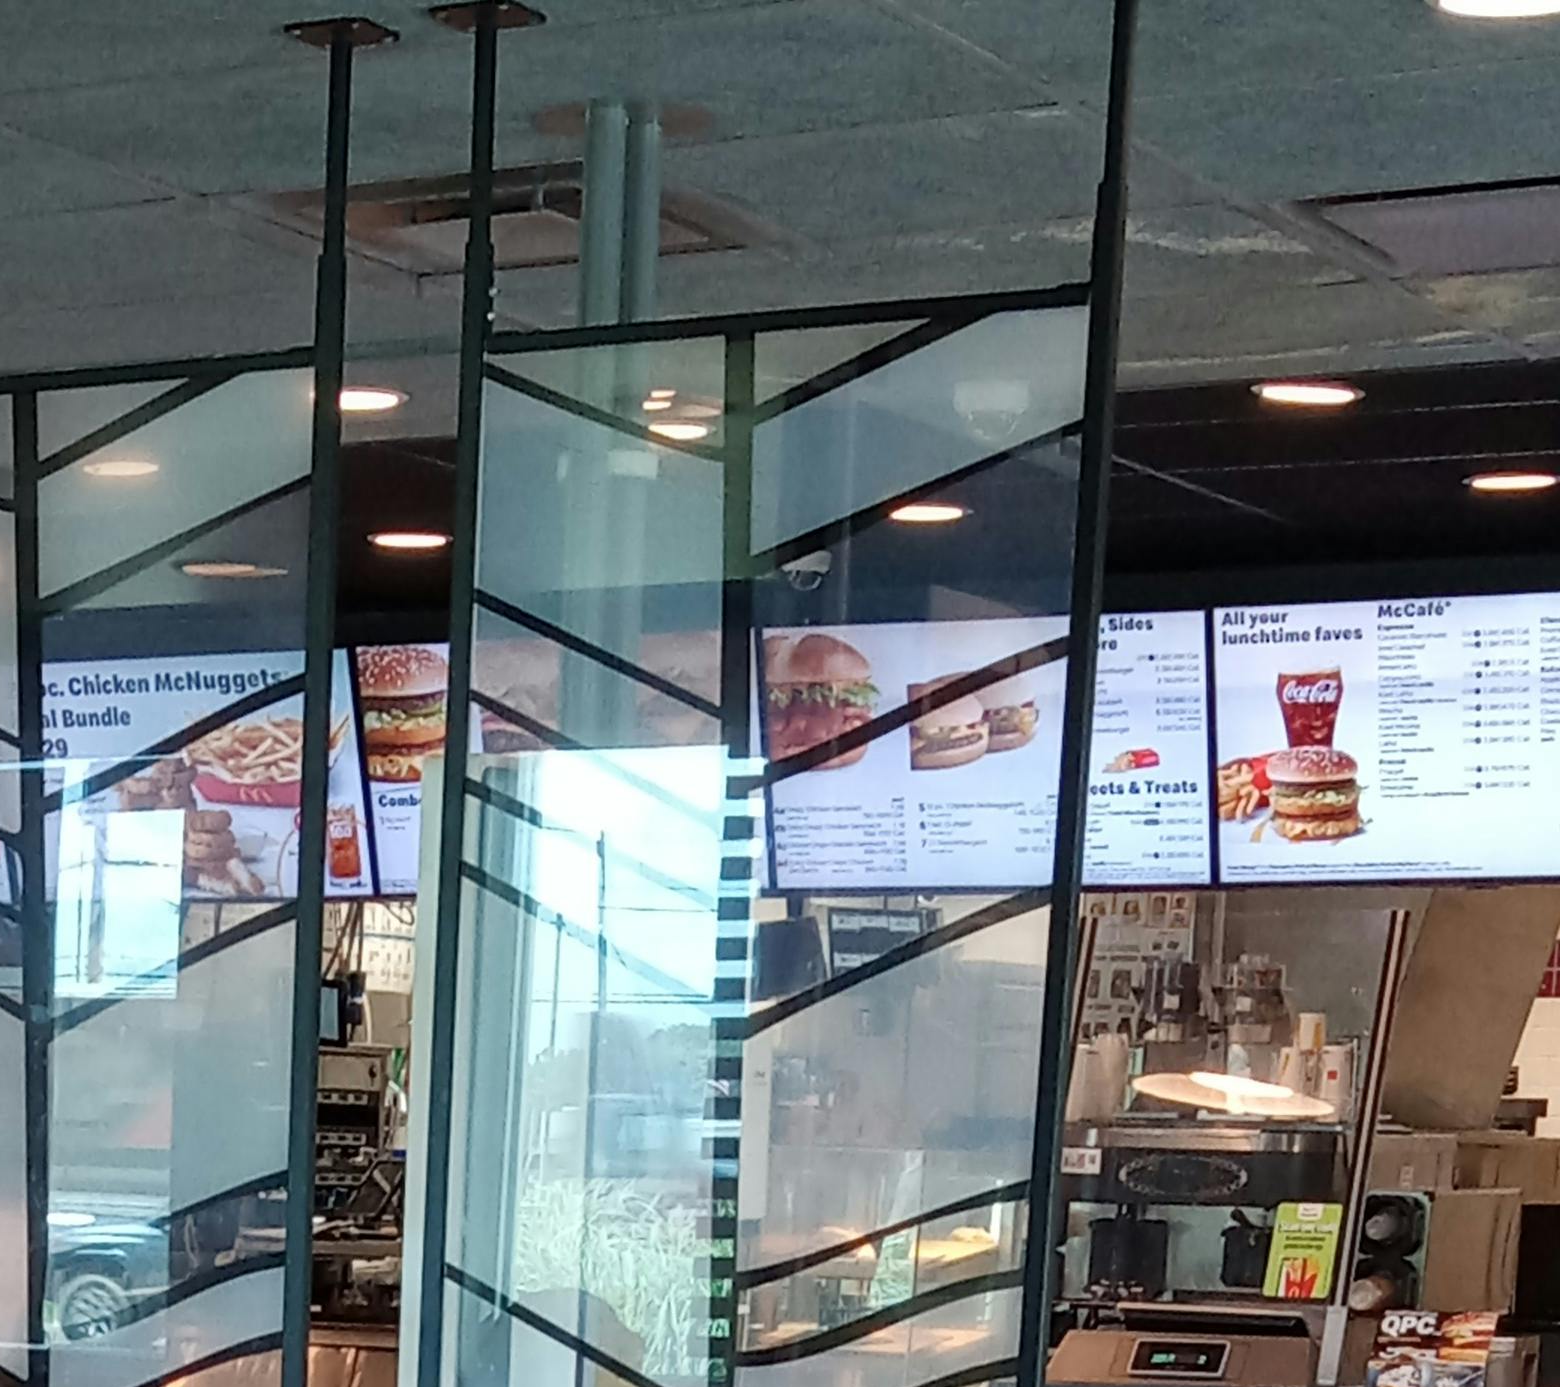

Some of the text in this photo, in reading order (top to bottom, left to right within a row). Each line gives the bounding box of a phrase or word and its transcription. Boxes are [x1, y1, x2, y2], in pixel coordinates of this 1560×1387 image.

[1108, 618, 1153, 631] Sides
[1221, 611, 1289, 629] All your
[1222, 628, 1310, 646] lunchtime
[1315, 626, 1363, 641] faves
[69, 673, 150, 697] Chicken
[62, 706, 131, 728] Bundle
[42, 738, 68, 759] 29
[1090, 781, 1197, 795] eets & Treats
[378, 794, 421, 807] Comb
[1381, 1315, 1437, 1337] QPC
